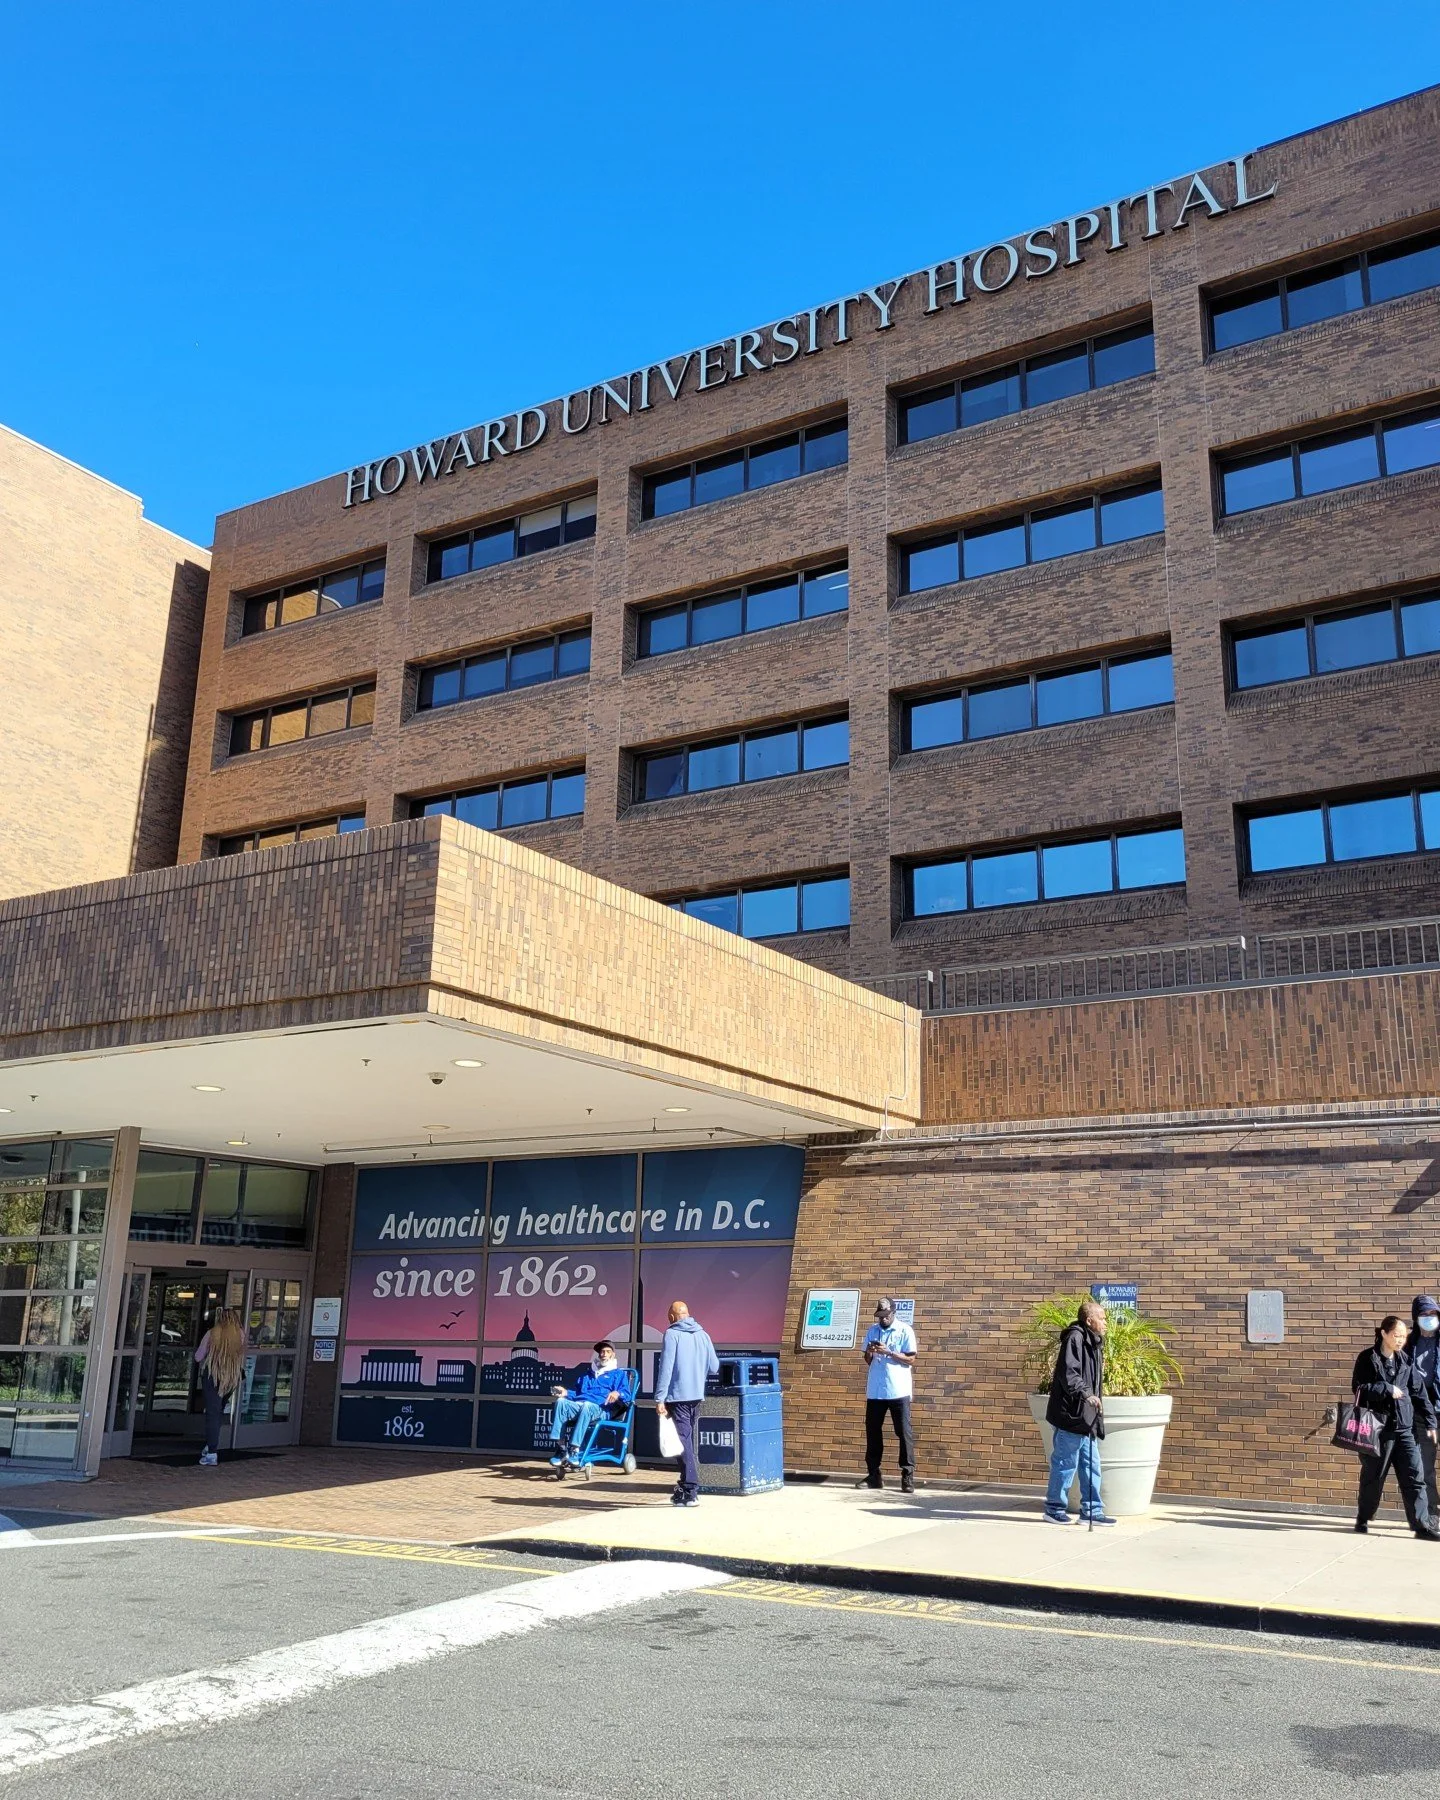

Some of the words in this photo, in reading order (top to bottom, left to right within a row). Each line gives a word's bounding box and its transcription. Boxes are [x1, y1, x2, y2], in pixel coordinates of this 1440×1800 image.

[343, 408, 547, 509] HOWARD
[562, 277, 907, 435] UNIVERSITY
[923, 154, 1280, 316] HOSPITAL
[378, 1208, 510, 1245] Advancing
[516, 1204, 667, 1236] healthcare
[674, 1200, 702, 1231] in
[712, 1198, 770, 1230] D.C.
[372, 1257, 476, 1298] since
[493, 1255, 608, 1297] 1862.
[894, 1301, 913, 1310] TICE
[315, 1341, 335, 1349] NOTICE
[401, 1404, 414, 1413] est.
[383, 1416, 425, 1438] 1862
[699, 1431, 734, 1447] HUH
